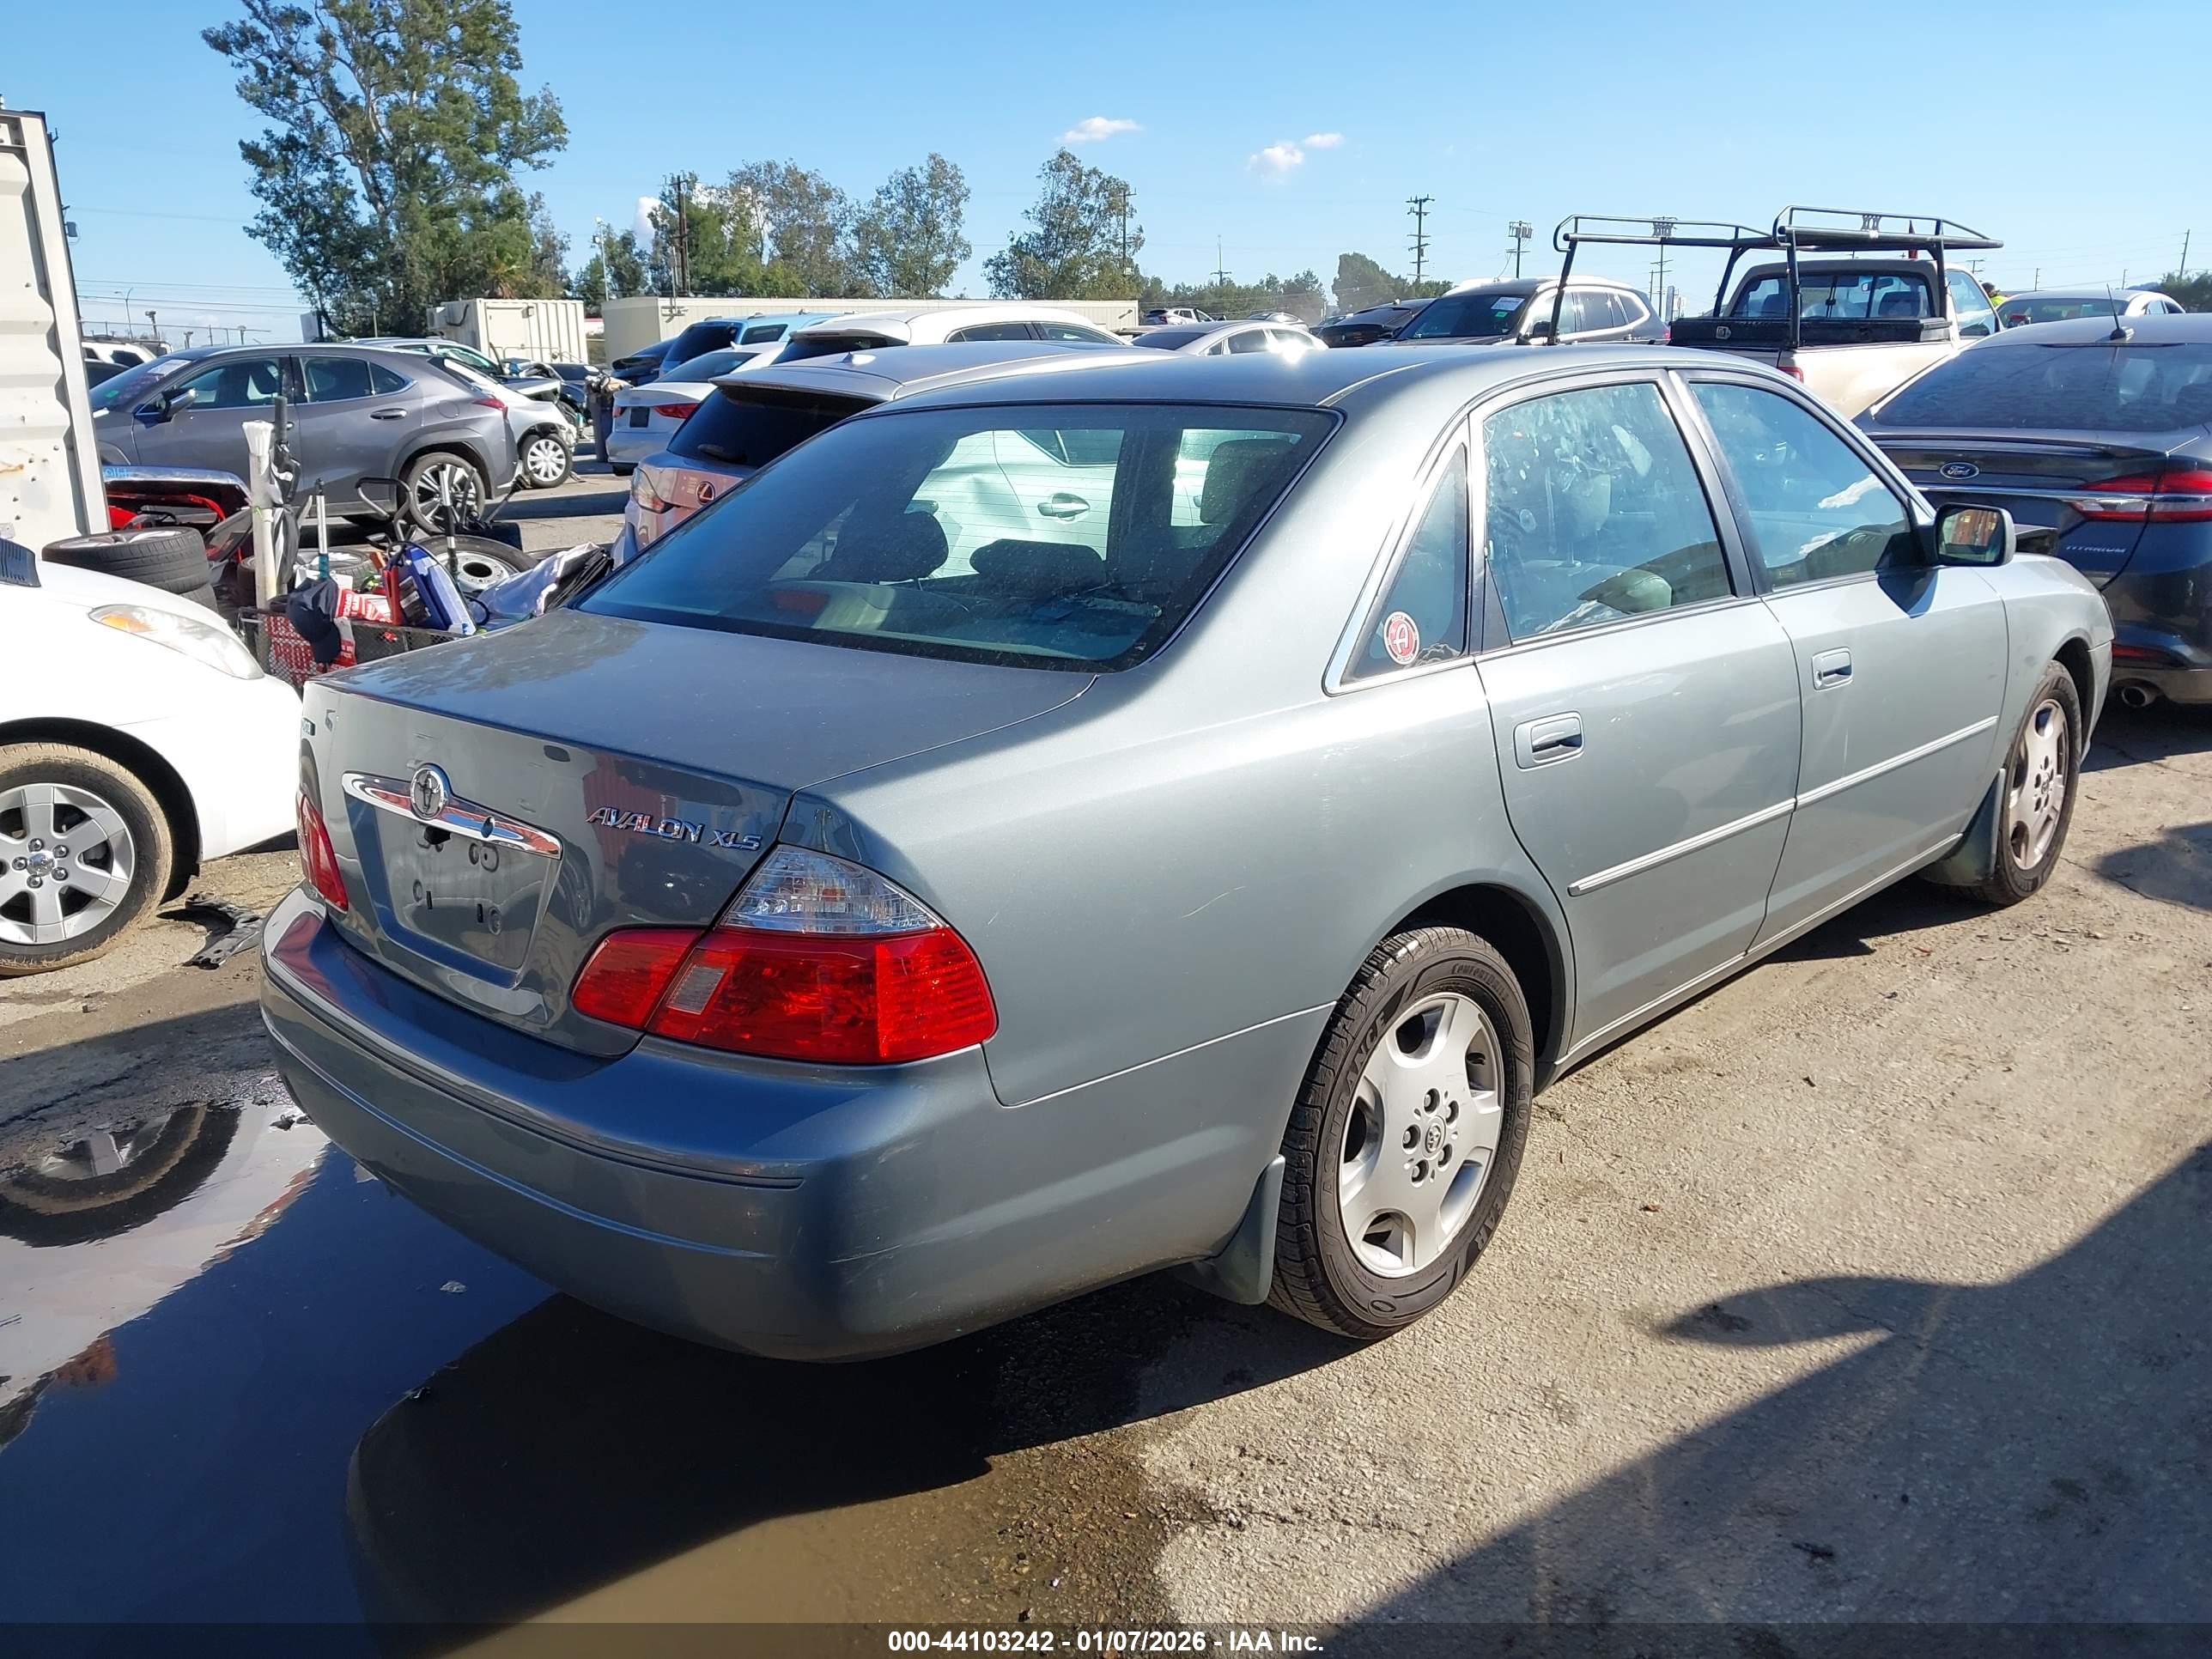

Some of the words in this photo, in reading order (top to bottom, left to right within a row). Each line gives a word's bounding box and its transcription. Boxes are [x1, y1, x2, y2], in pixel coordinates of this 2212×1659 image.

[586, 805, 704, 843] AVALON
[708, 829, 763, 851] XLS
[1323, 1010, 1386, 1195] ASSURANCE
